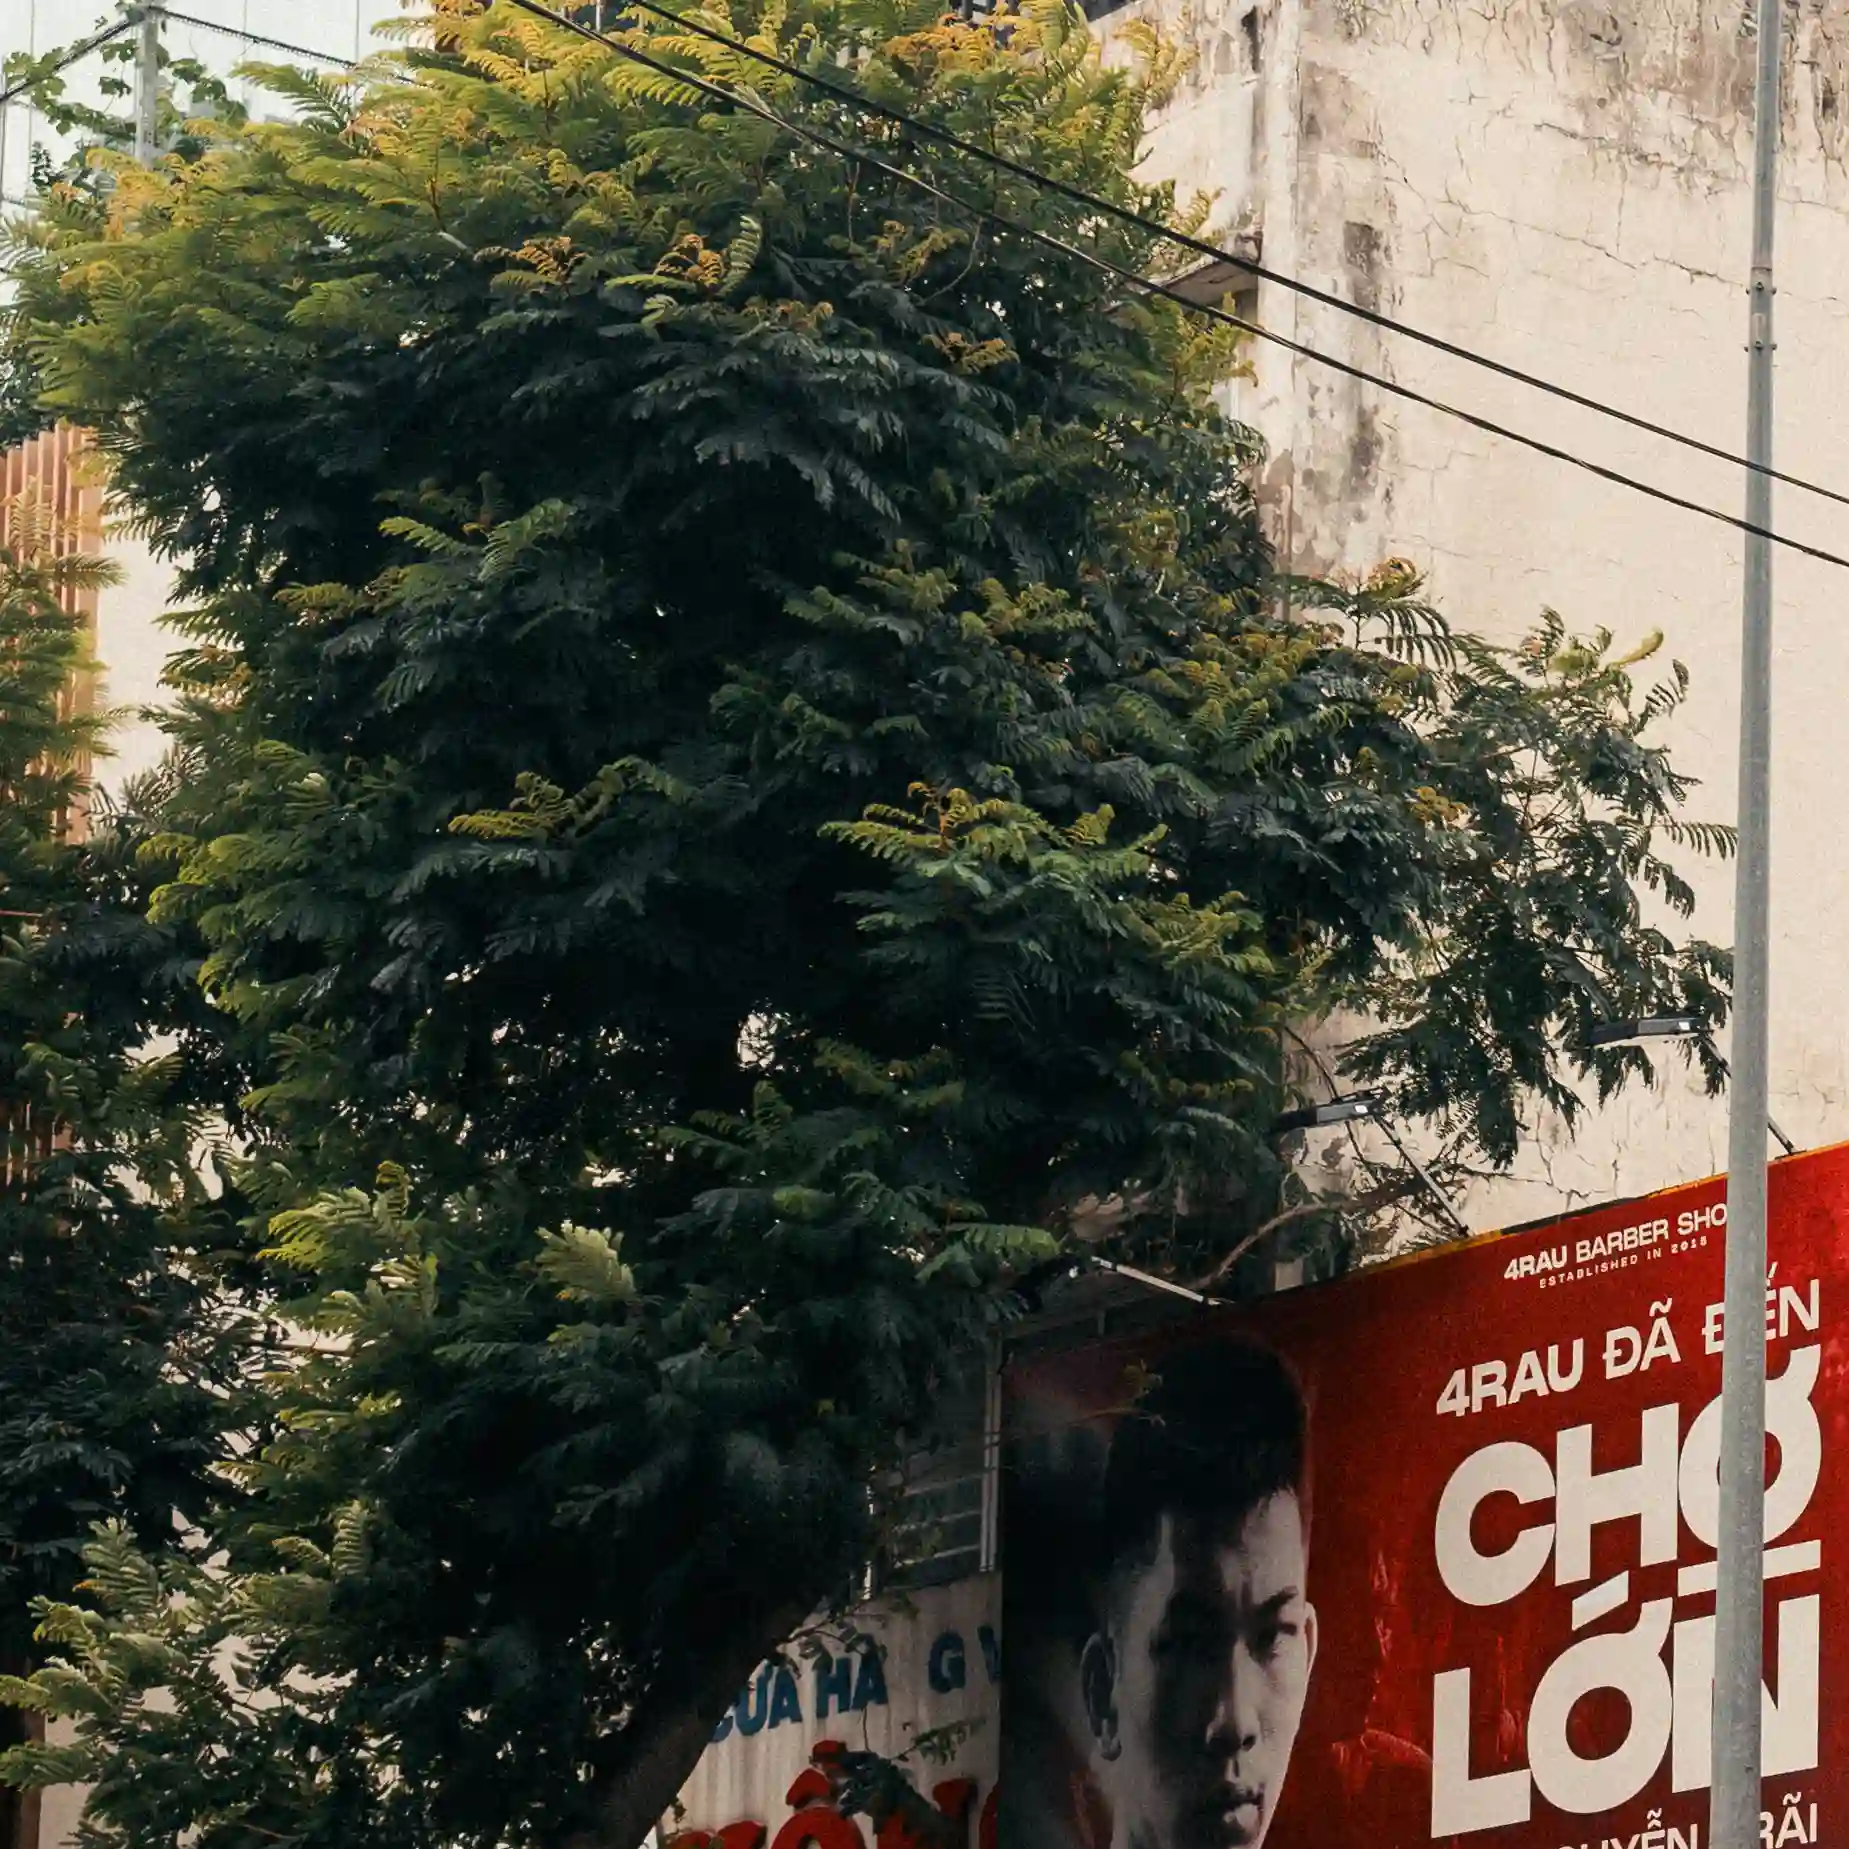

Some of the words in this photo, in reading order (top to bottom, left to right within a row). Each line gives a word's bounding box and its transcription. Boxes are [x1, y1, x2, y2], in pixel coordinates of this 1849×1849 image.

[1504, 1247, 1568, 1281] 4RAU
[1576, 1219, 1669, 1263] BARBER
[1678, 1203, 1728, 1237] SHO
[1539, 1254, 1638, 1290] ESTABLISHED
[1647, 1247, 1662, 1261] IN
[1436, 1338, 1584, 1418] 4RAU
[1603, 1297, 1681, 1380] ĐÃ
[1435, 1344, 1822, 1607] CHỢ
[1431, 1571, 1820, 1838] LỚN
